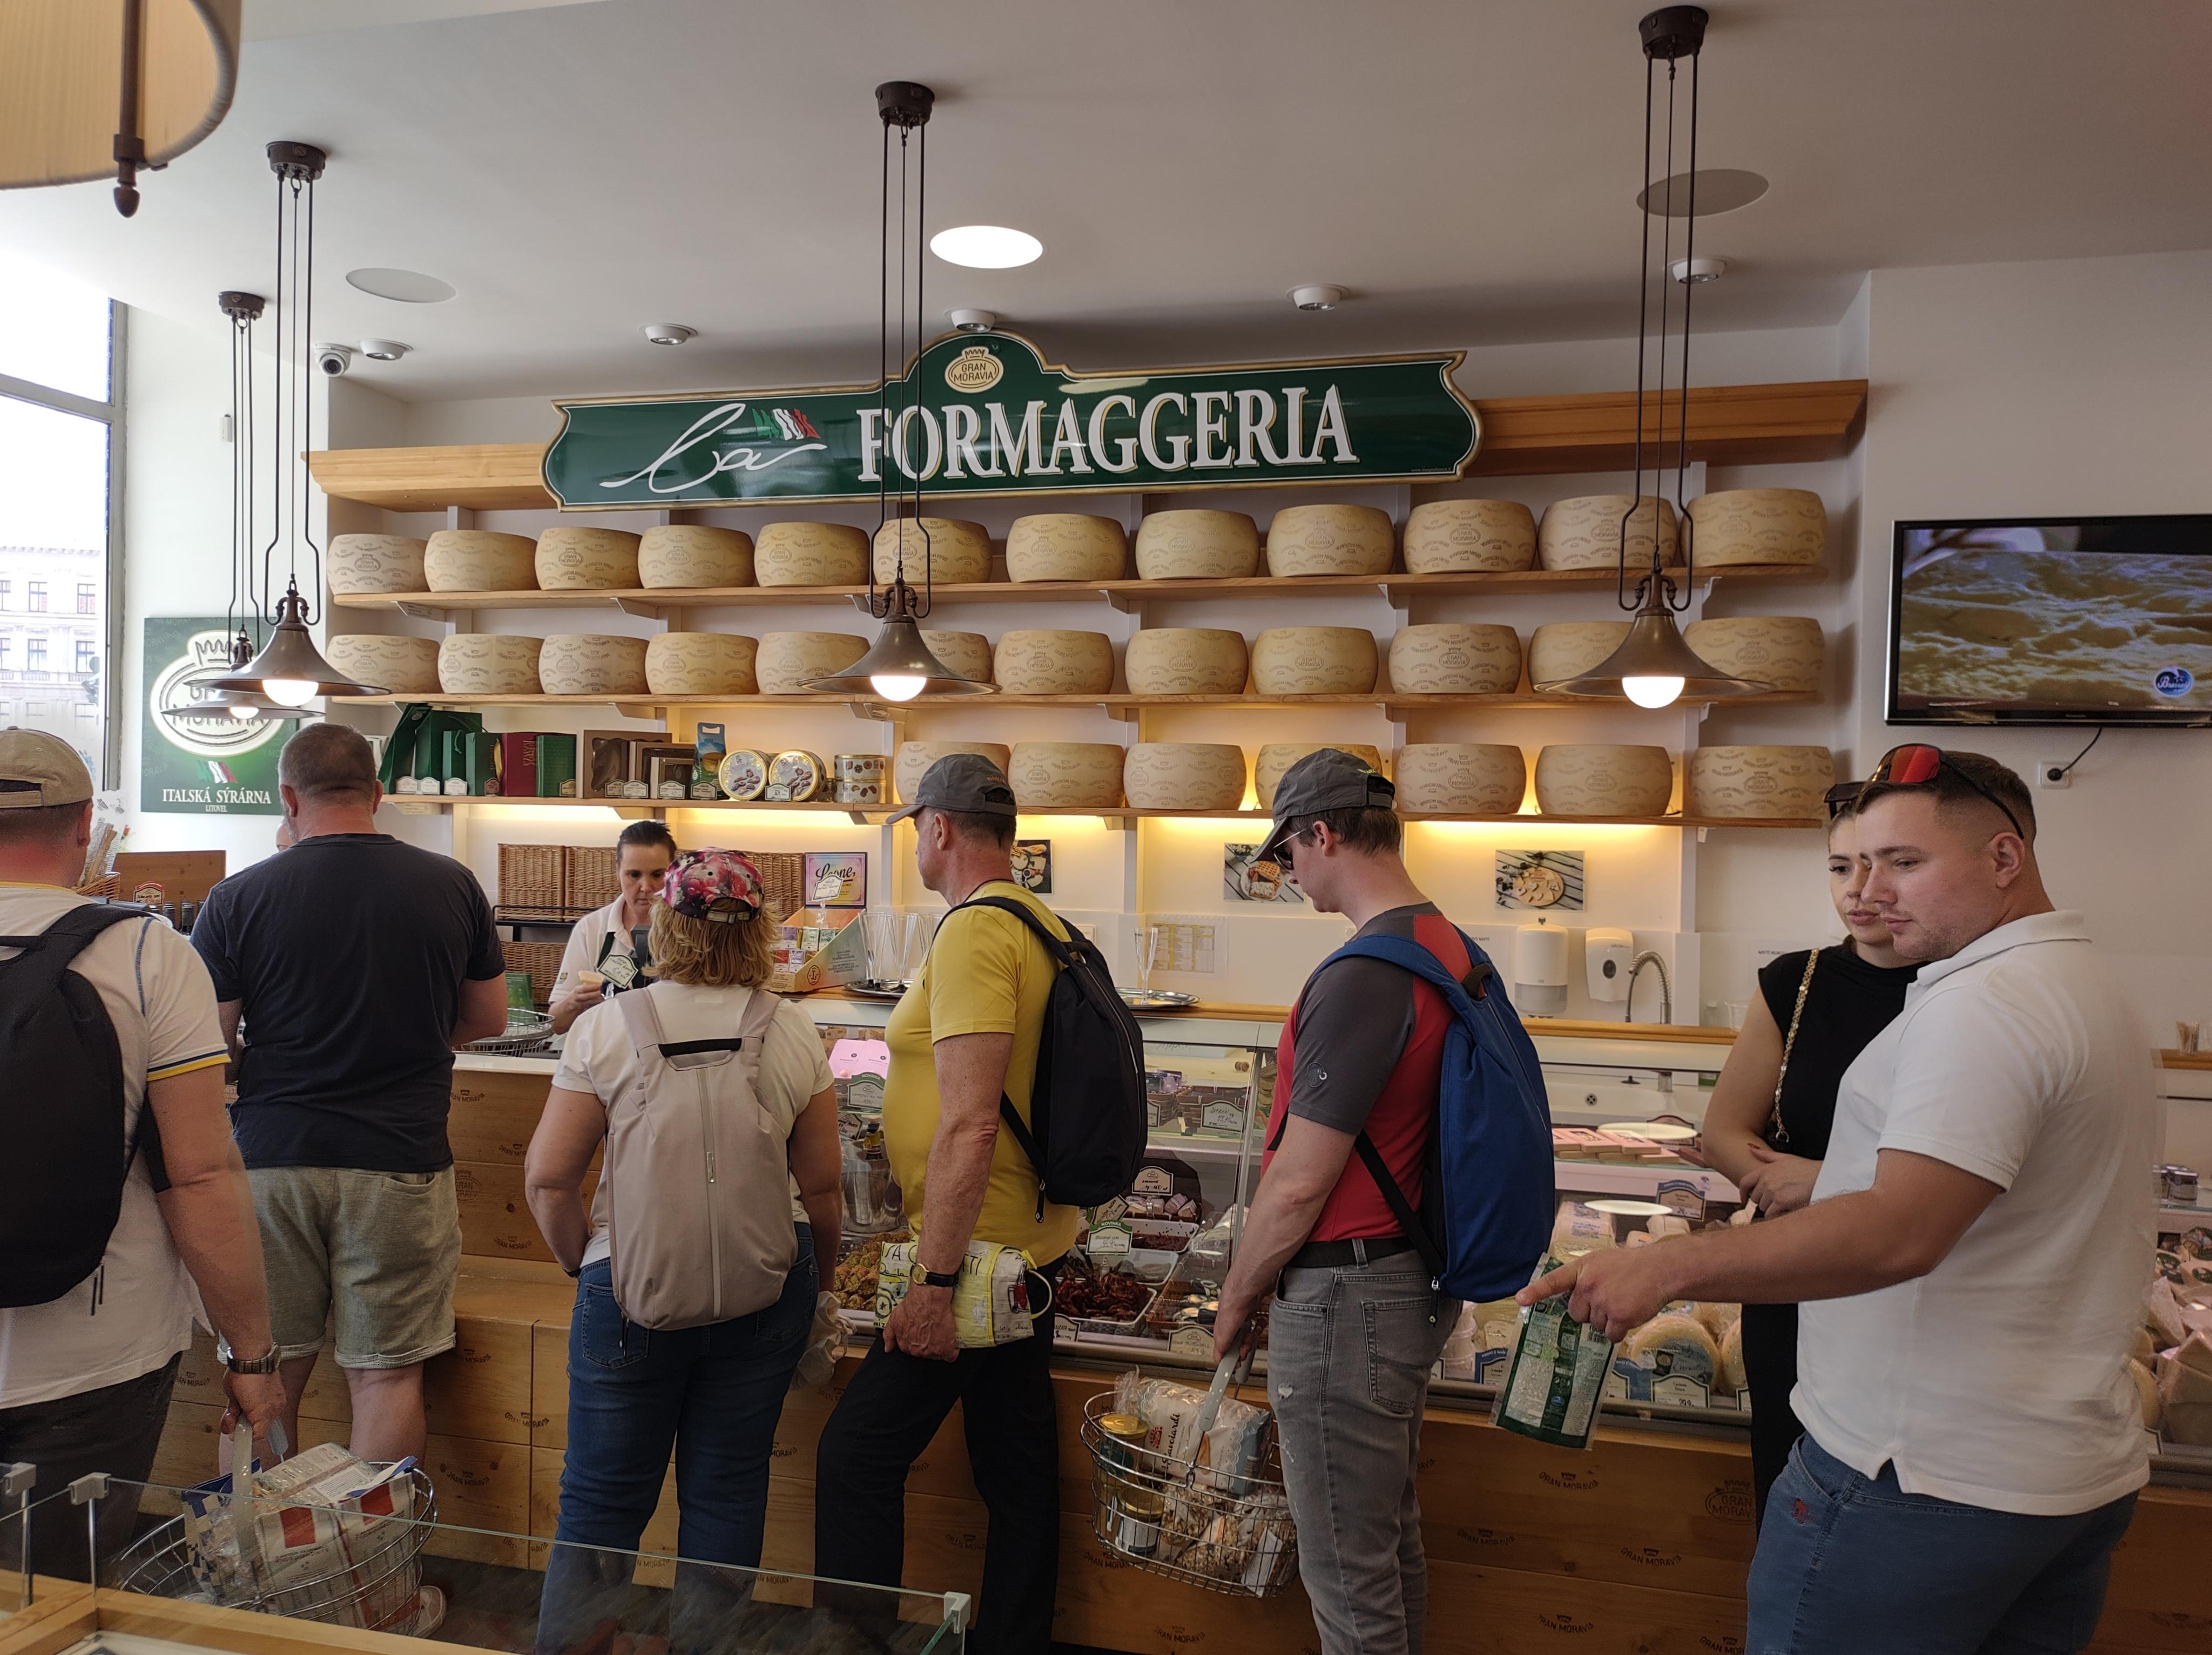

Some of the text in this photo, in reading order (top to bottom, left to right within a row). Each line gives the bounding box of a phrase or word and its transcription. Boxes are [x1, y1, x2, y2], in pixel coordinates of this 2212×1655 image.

[961, 363, 987, 374] GRAN
[953, 371, 995, 382] MORAVIA
[857, 383, 1360, 482] FORMAGGERIA
[162, 786, 272, 804] ITALSKÁ SÝRÁRNA
[205, 805, 227, 813] LITOVEL
[451, 1093, 460, 1102] RAN
[1539, 1471, 1600, 1491] GRAN MORAVIA
[1711, 1495, 1754, 1516] GRAN MORAV
[1620, 1547, 1683, 1566] GRAN MORAVIA
[1557, 1621, 1595, 1634] MORAVIA
[1174, 1632, 1206, 1644] MORAVIA
[1699, 1635, 1723, 1653] GRAN
